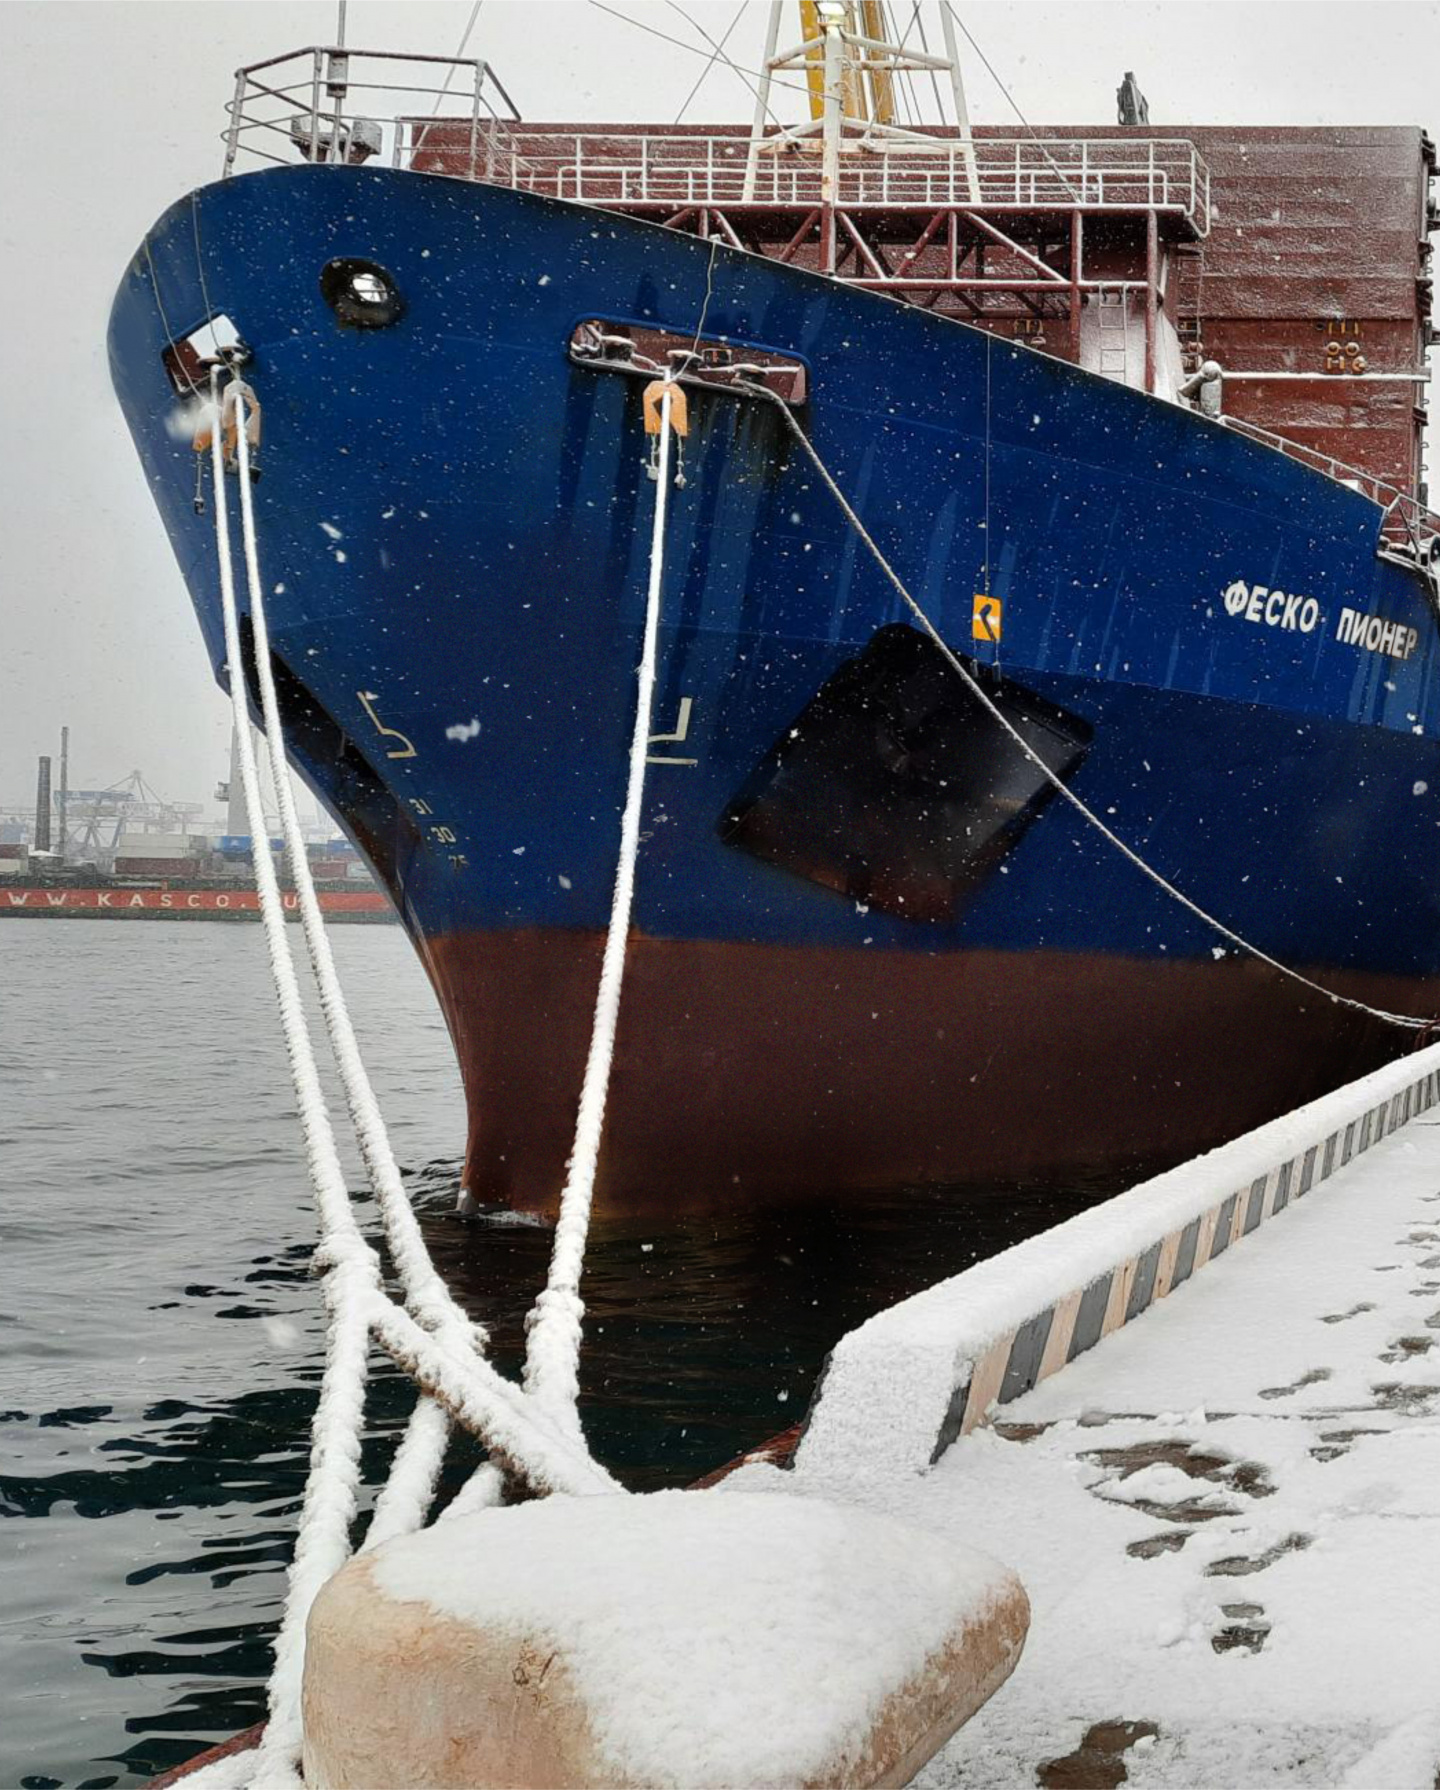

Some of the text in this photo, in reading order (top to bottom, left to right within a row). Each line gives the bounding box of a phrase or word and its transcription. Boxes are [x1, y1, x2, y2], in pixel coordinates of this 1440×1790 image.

[1223, 580, 1418, 660] ФЕСКО ПИОНЕР
[431, 826, 457, 843] 30
